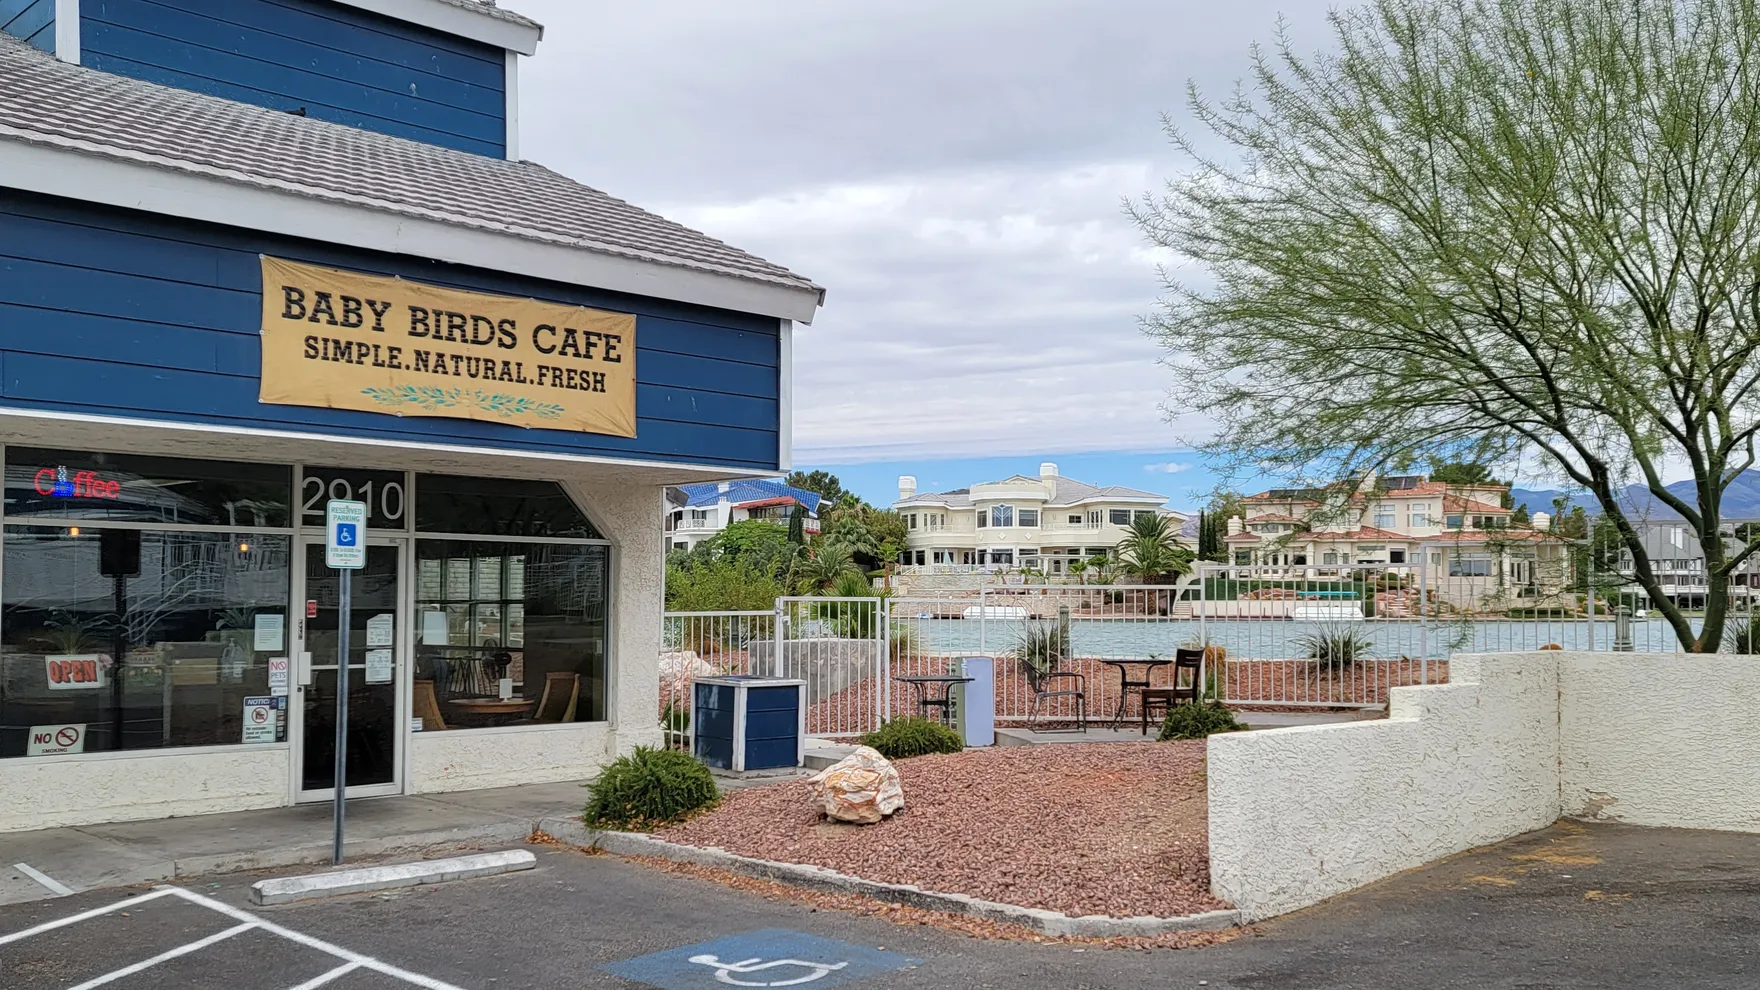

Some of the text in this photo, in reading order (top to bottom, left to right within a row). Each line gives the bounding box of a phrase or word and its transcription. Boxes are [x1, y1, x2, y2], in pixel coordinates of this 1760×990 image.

[281, 285, 621, 363] BABY BIRDS CAFE
[301, 476, 404, 520] 2910
[331, 507, 362, 515] RESERVED
[49, 660, 98, 684] OPEN
[271, 661, 287, 670] NO
[34, 733, 52, 744] NO
